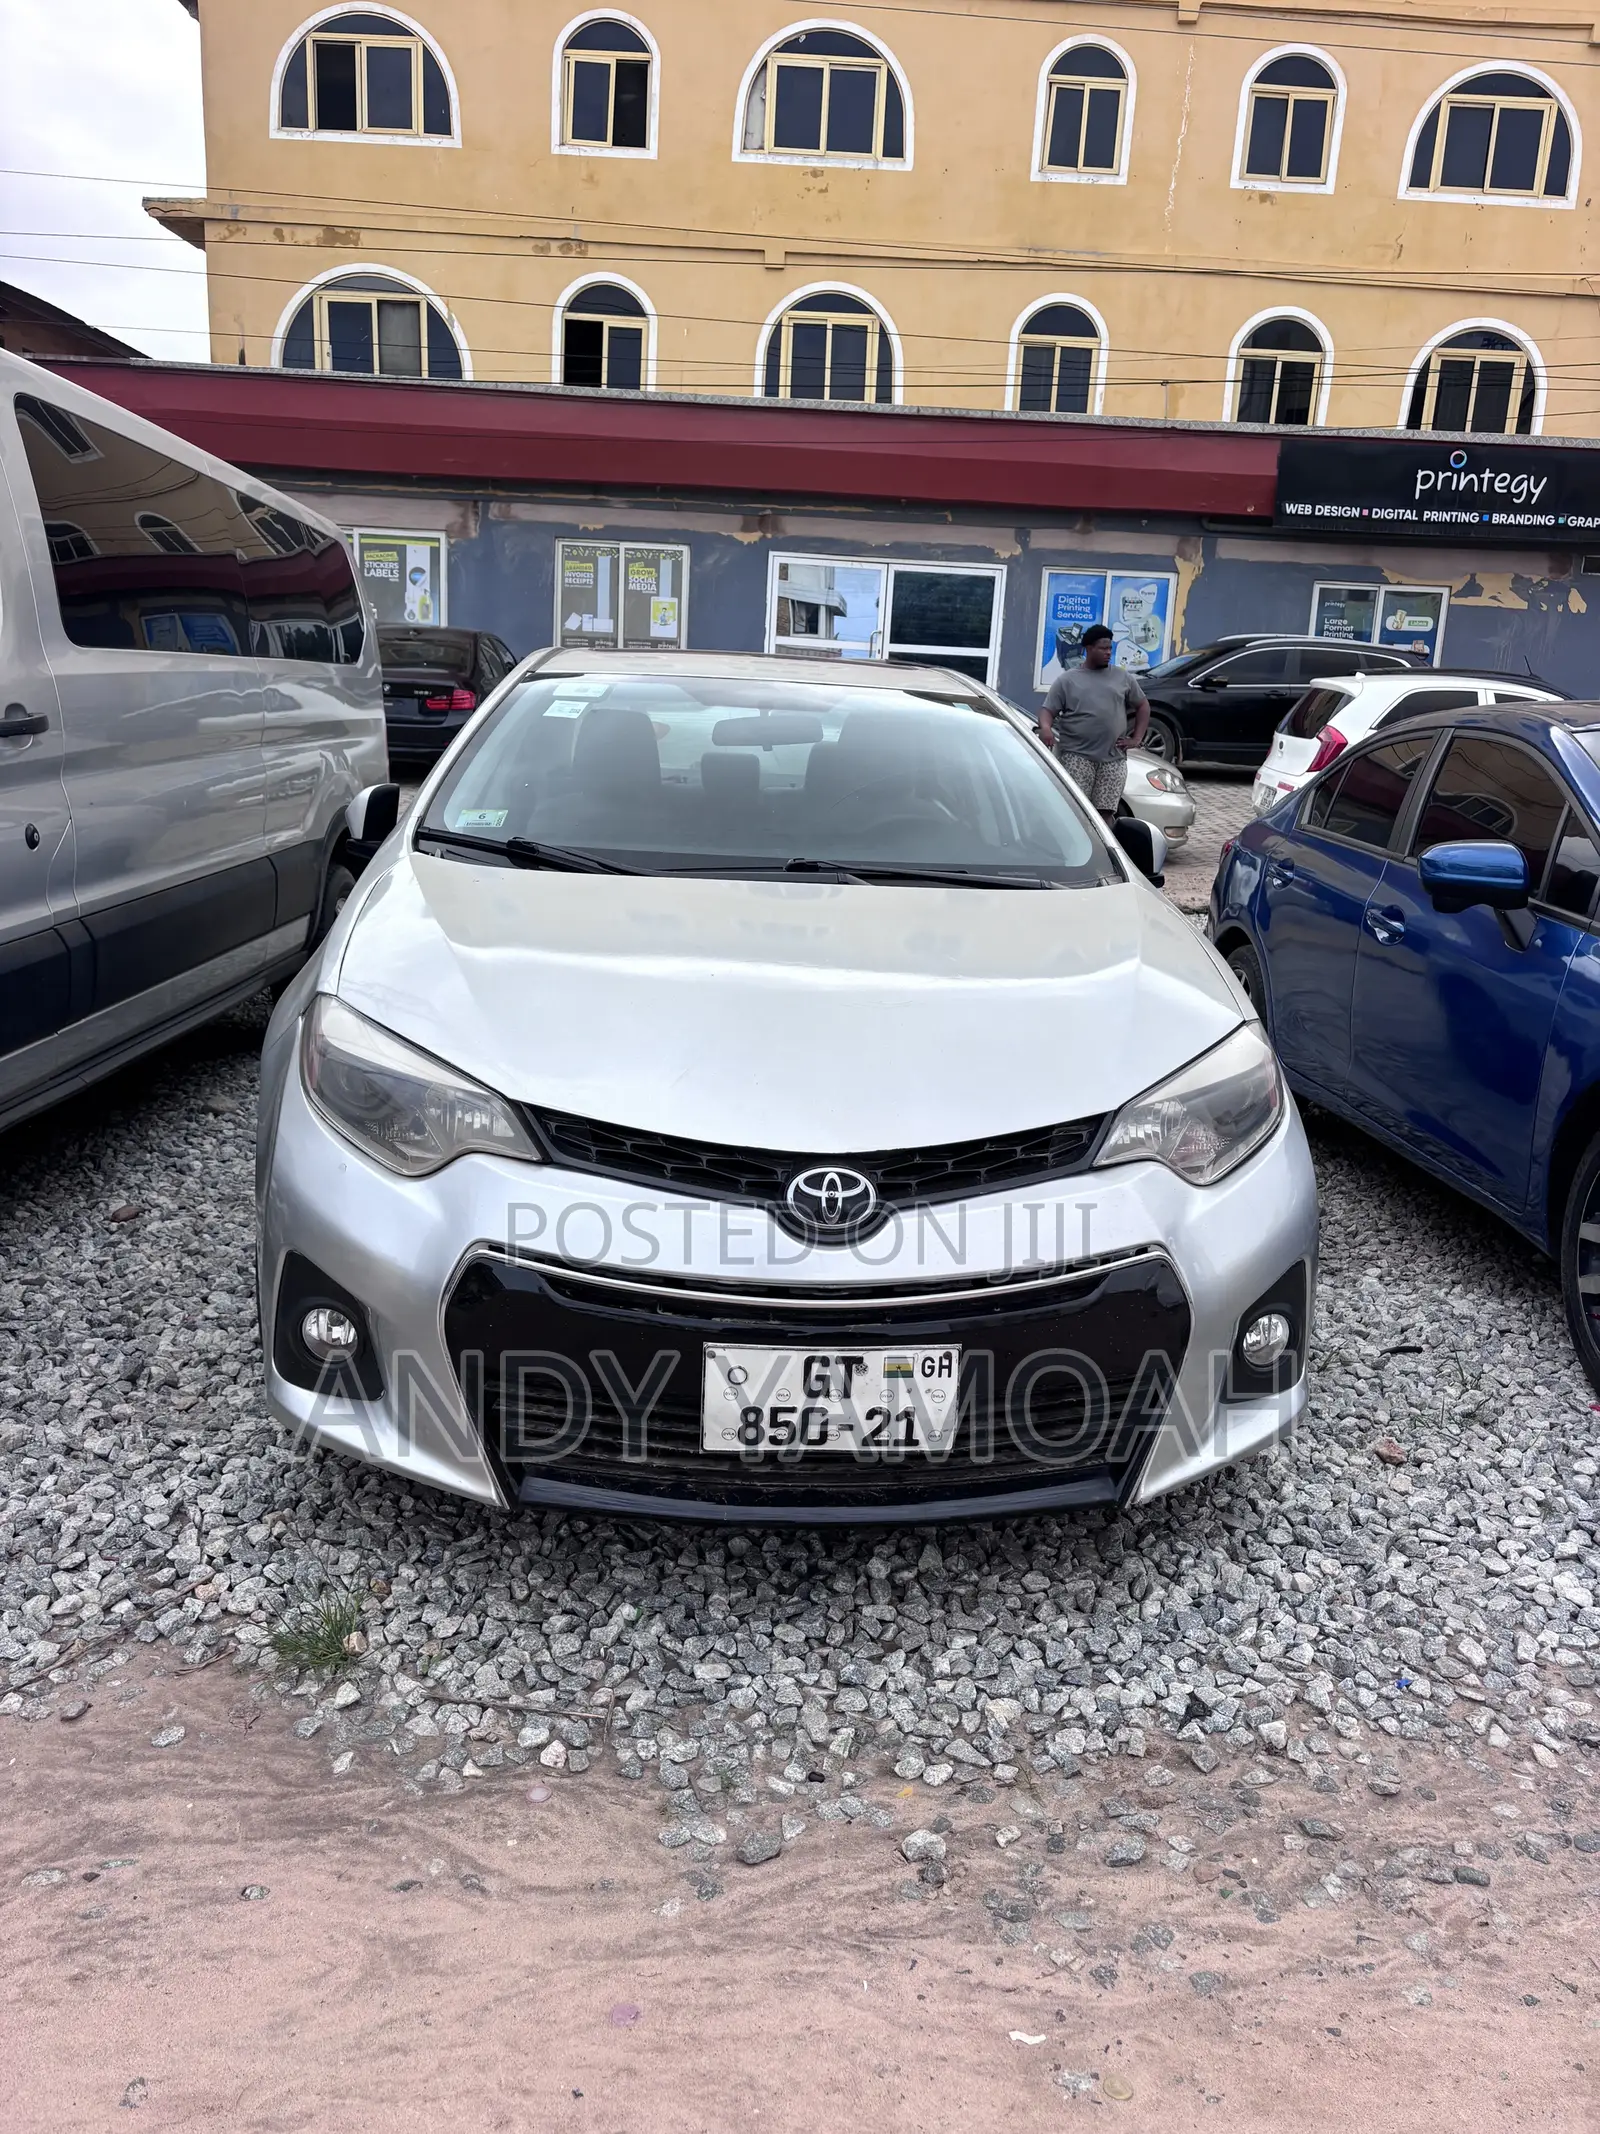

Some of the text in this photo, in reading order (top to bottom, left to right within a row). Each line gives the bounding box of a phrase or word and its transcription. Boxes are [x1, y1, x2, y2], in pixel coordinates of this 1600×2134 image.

[1415, 466, 1548, 505] printegy
[1285, 503, 1600, 528] WEB DESIGN DIGITAL PRINTING BRANDING GRAP
[364, 568, 399, 577] LABELS
[628, 583, 657, 591] MEDIA
[1058, 595, 1091, 605] Digital
[1057, 603, 1091, 613] Printing
[1056, 611, 1093, 619] Services
[1324, 617, 1348, 625] Large
[1323, 624, 1354, 632] Format
[1323, 631, 1354, 640] Printing
[478, 812, 487, 820] 6
[921, 1356, 953, 1379] GH
[803, 1355, 863, 1400] GT
